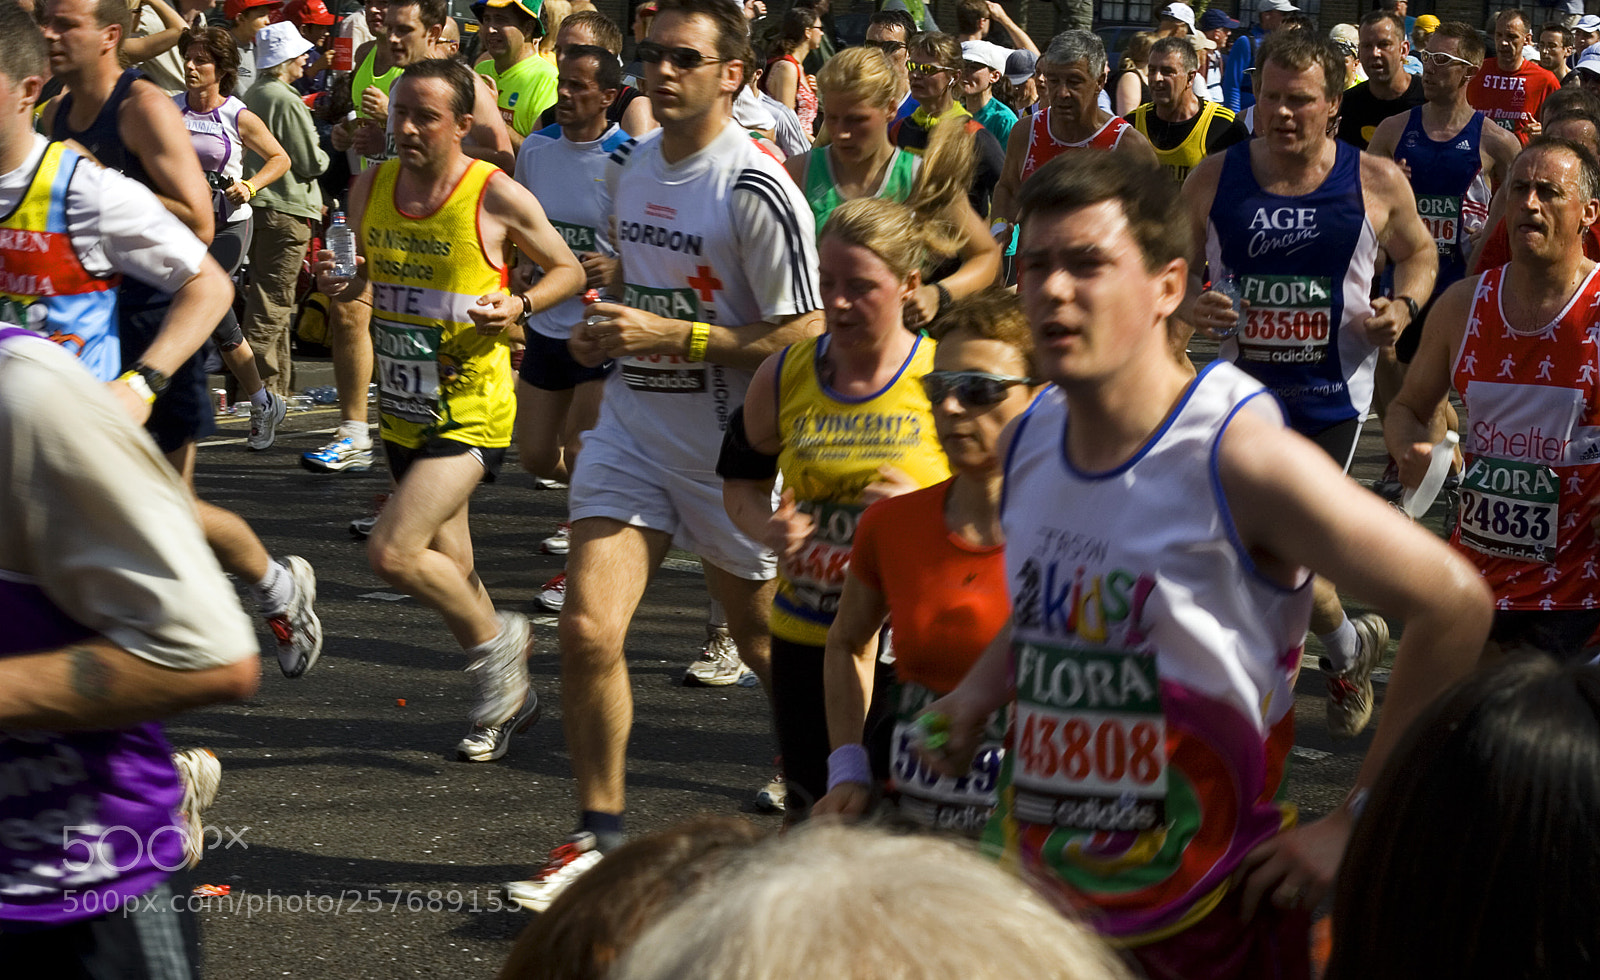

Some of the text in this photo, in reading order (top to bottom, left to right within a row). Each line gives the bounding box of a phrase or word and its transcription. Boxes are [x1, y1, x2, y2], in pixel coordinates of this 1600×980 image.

[1483, 74, 1527, 91] STEVE
[1248, 207, 1317, 230] AGE
[1417, 197, 1456, 214] ORA
[620, 220, 704, 257] GORDON
[1249, 229, 1321, 258] Concern
[373, 252, 434, 282] Hospice
[1243, 277, 1328, 305] FLORA
[1244, 309, 1329, 341] 33500
[1271, 348, 1323, 364] adidas
[1472, 421, 1573, 463] Shelter
[1466, 457, 1554, 496] FLORA
[1462, 491, 1552, 541] 24833
[1017, 641, 1156, 708] FLORA
[1018, 712, 1162, 786] 43808
[1056, 797, 1158, 831] adidas
